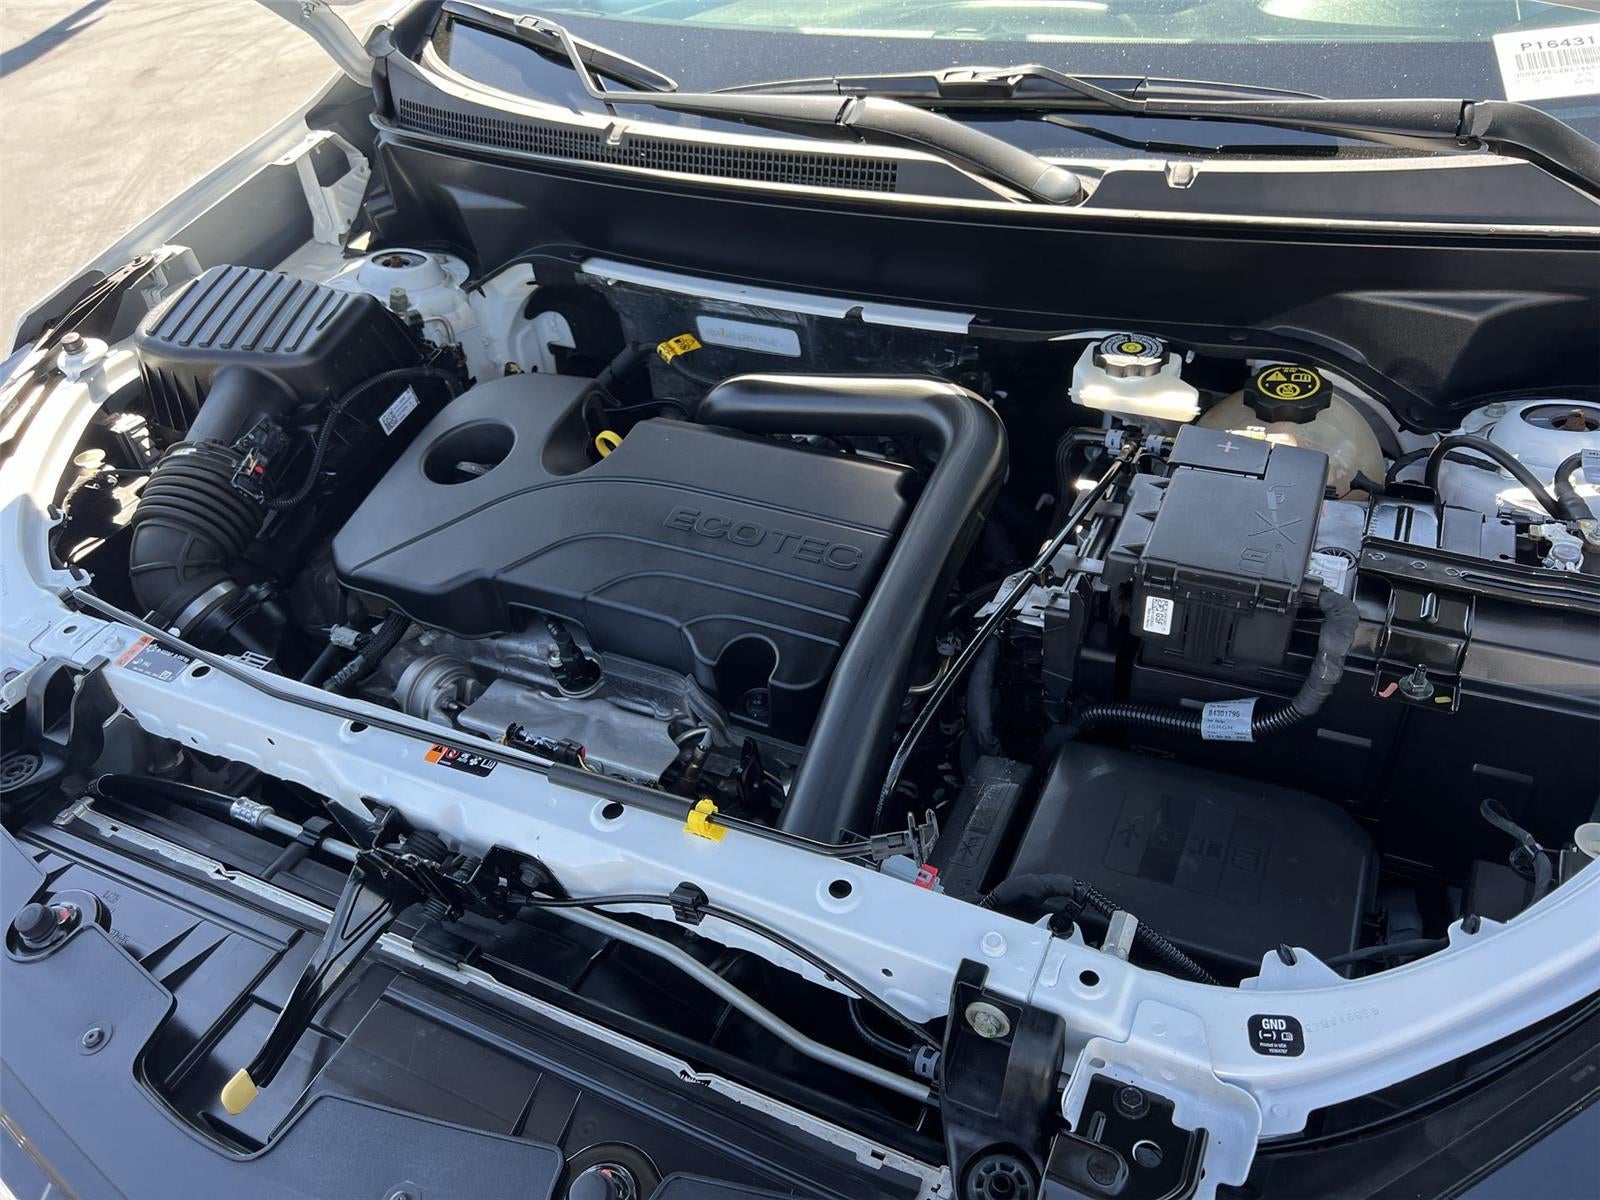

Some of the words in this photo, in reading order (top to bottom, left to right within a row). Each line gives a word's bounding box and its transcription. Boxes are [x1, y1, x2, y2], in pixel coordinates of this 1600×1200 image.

[1520, 35, 1595, 51] P16431
[663, 503, 863, 571] ECOTEC
[1261, 1018, 1286, 1030] GND
